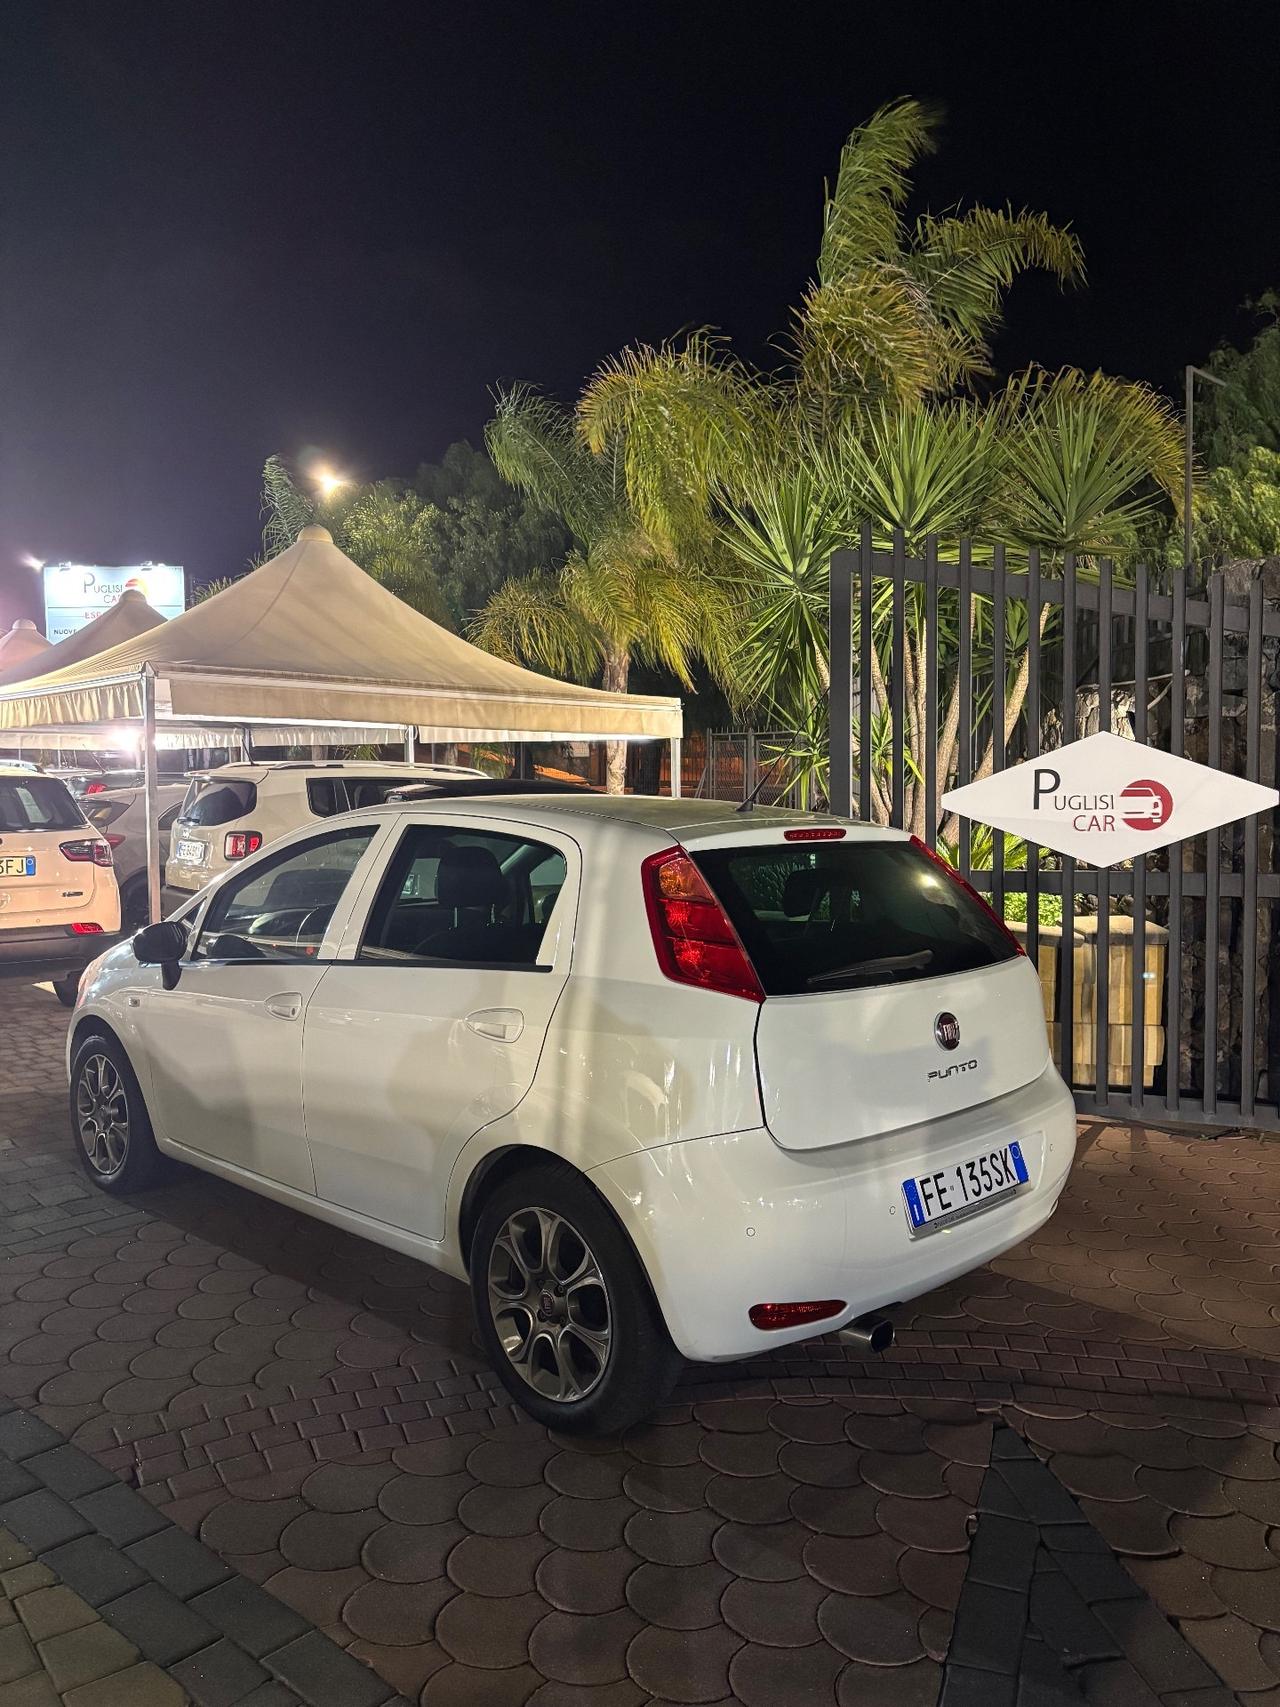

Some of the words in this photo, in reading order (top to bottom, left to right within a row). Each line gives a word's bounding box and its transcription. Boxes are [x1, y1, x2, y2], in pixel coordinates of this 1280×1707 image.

[84, 572, 123, 593] PUGLISI
[1032, 768, 1115, 811] PUGLISI
[1073, 814, 1116, 832] CAR
[927, 1059, 978, 1083] PUNTO
